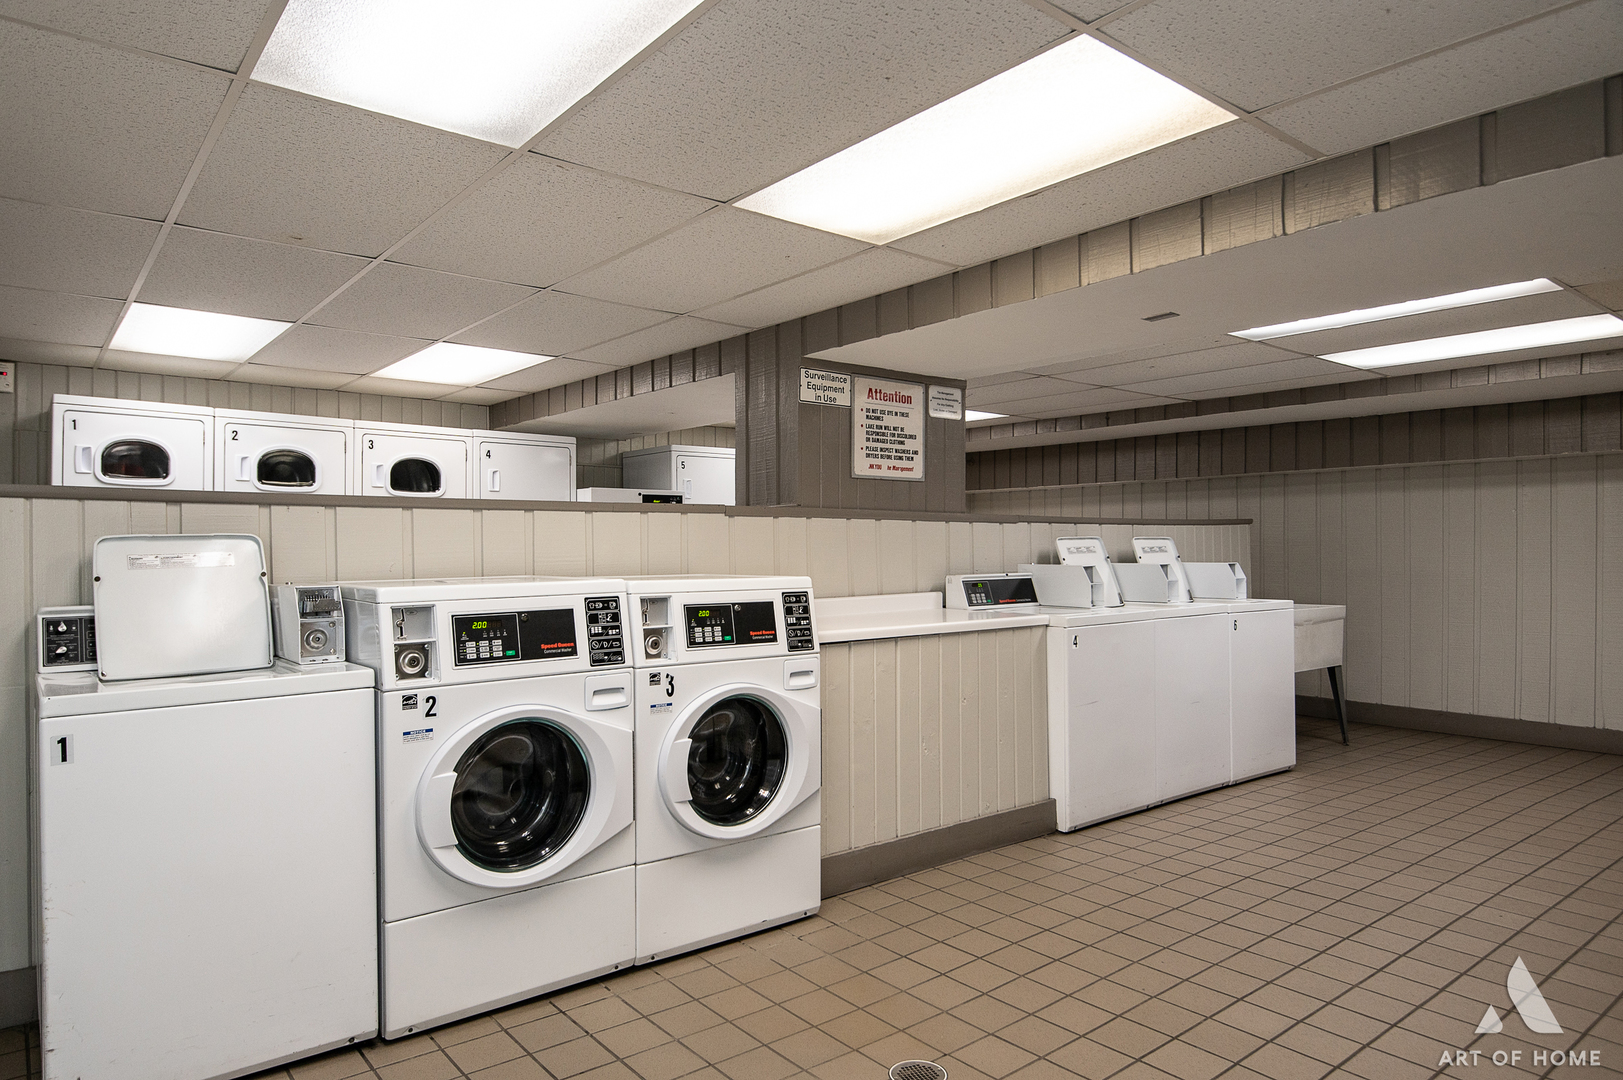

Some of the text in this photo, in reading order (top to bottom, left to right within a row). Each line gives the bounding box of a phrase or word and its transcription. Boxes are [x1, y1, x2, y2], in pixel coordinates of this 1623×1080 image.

[804, 370, 847, 384] Surveillance
[806, 381, 845, 394] Equipment
[815, 393, 837, 403] in Use
[867, 387, 912, 404] Attention
[72, 419, 76, 430] 1
[232, 430, 238, 440] 2
[369, 440, 373, 449] 3
[486, 450, 491, 459] 4
[681, 461, 685, 469] 5
[472, 621, 487, 629] 2.00
[1233, 620, 1237, 631] 6
[1073, 635, 1078, 648] 4
[666, 673, 674, 697] 3
[425, 696, 436, 717] 2
[57, 737, 67, 762] 1
